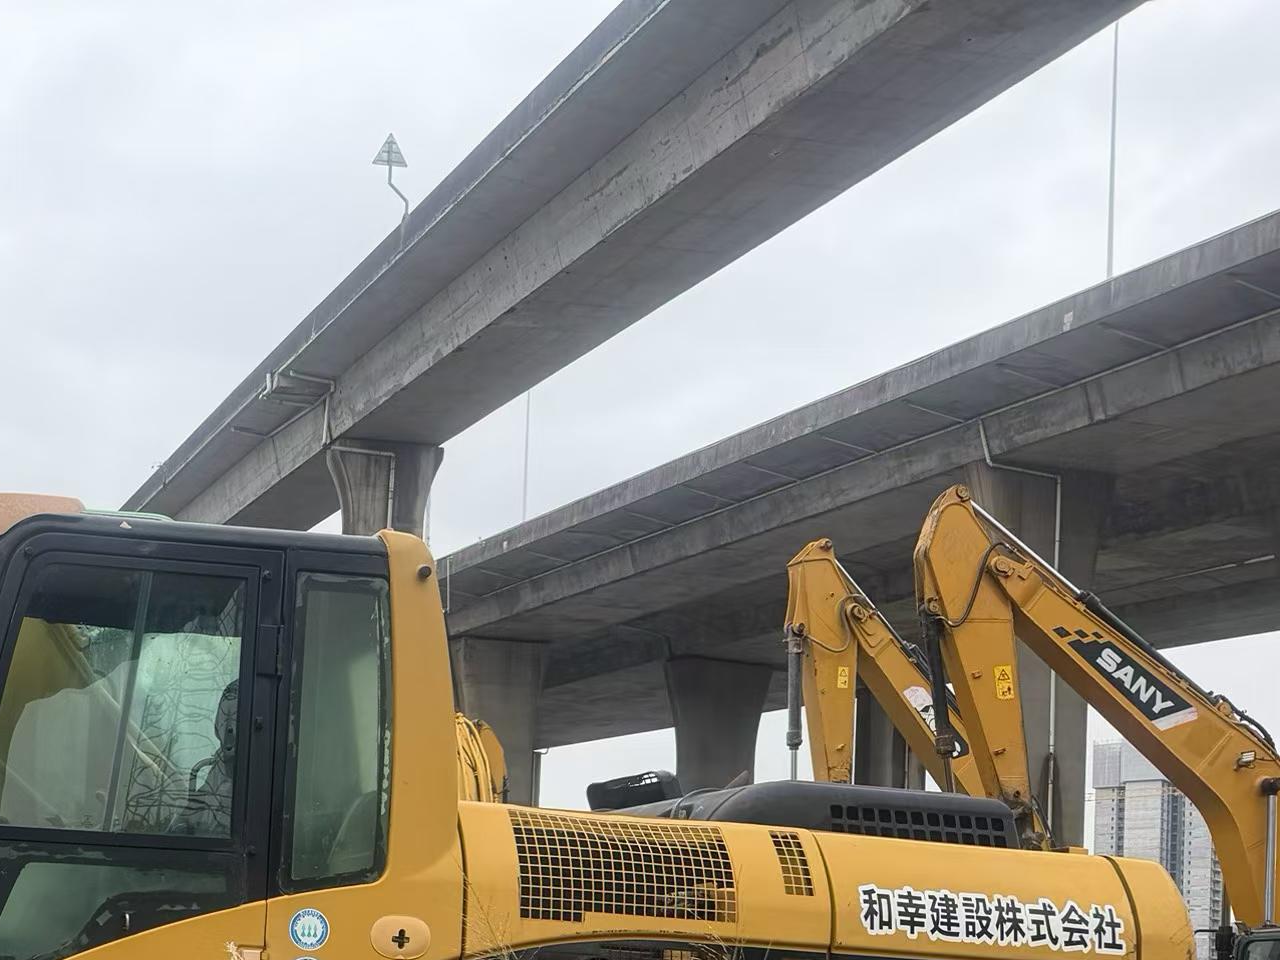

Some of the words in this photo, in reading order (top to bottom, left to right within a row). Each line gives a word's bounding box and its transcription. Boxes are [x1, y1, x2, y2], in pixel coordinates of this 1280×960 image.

[1096, 647, 1175, 714] SANY
[860, 886, 1125, 952] 和幸建設株式会社
